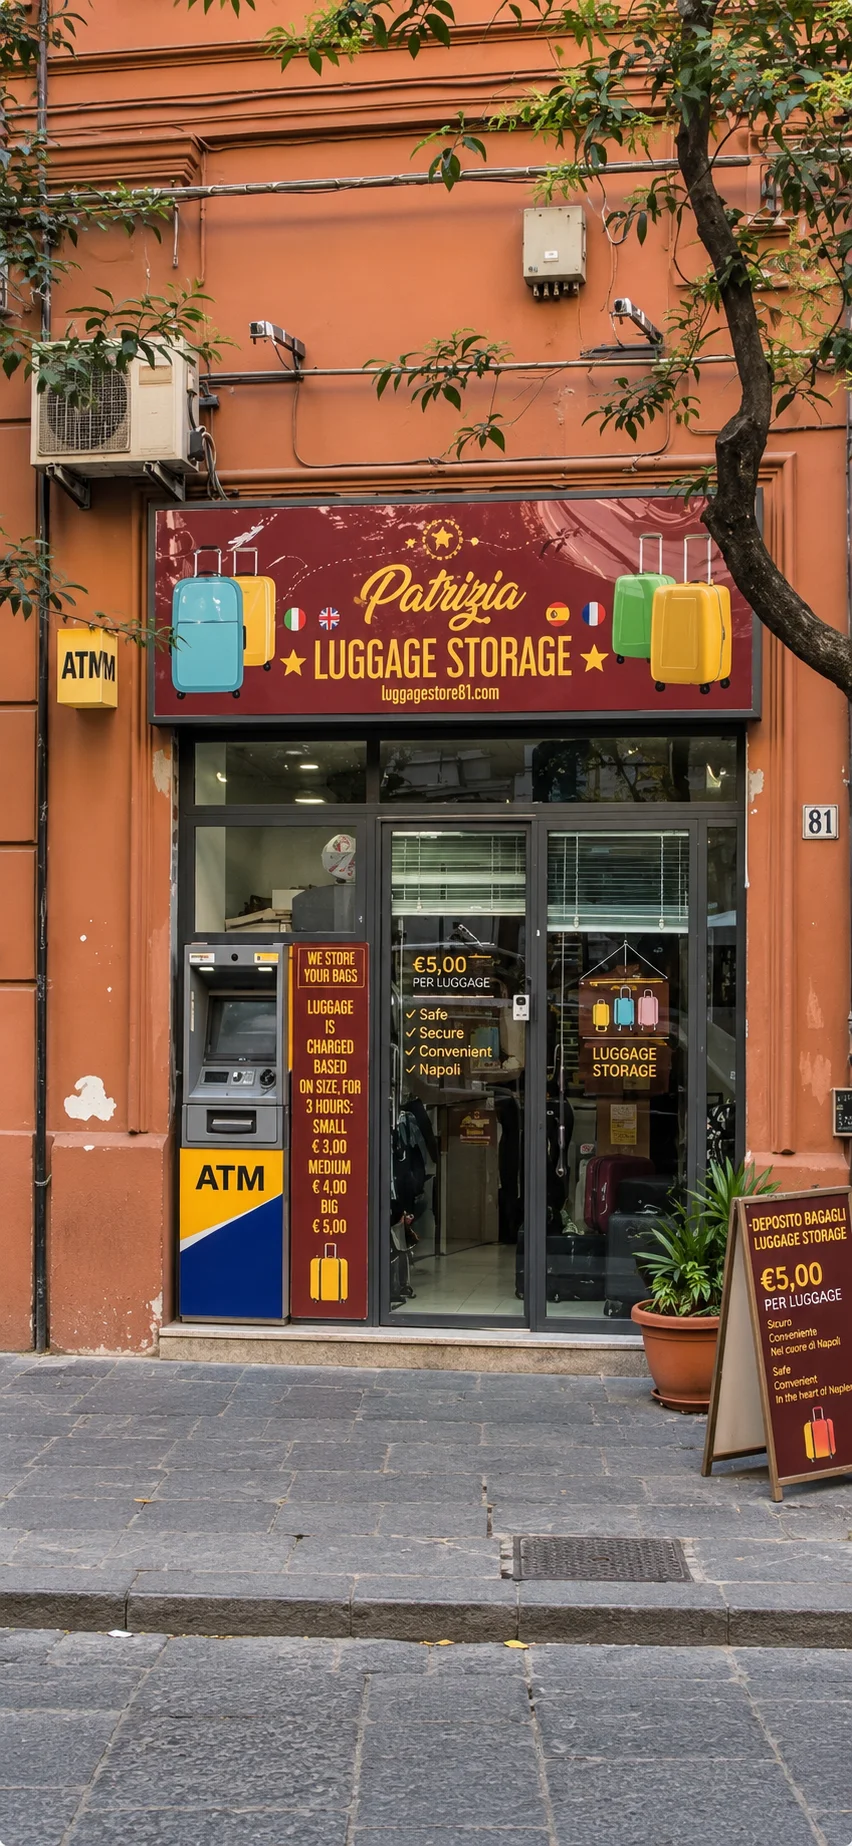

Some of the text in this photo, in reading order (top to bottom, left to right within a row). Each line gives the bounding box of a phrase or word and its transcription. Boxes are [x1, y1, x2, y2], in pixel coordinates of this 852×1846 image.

[359, 563, 527, 632] Patrizia
[314, 635, 573, 680] LUGGAGE STORAGE
[381, 684, 500, 704] luggagestore81.com
[808, 809, 832, 834] 81
[307, 951, 355, 966] WE STORE
[412, 956, 467, 976] €5,00
[304, 968, 358, 983] YOUR BAGS
[413, 977, 491, 988] PER LUGGAGE
[307, 999, 354, 1015] LUGGAGE
[419, 1007, 448, 1020] Safe
[325, 1019, 336, 1034] IS
[419, 1026, 464, 1039] Secure
[306, 1039, 354, 1054] CHARGED
[419, 1044, 492, 1058] Convenient
[592, 1047, 657, 1061] LUGGAGE
[313, 1059, 347, 1074] BASED
[419, 1063, 461, 1078] Napoli
[592, 1063, 657, 1078] STORAGE
[299, 1079, 361, 1095] ON SIZE, FOR
[305, 1098, 354, 1114] 3 HOURS:
[312, 1119, 347, 1134] SMALL
[311, 1139, 347, 1156] € 3,00
[308, 1159, 351, 1175] MEDIUM
[195, 1164, 265, 1191] ATM
[311, 1179, 347, 1197] € 4,00
[321, 1199, 338, 1214] BIG
[804, 1208, 846, 1225] BAGAGLI
[312, 1218, 347, 1236] € 5,00
[754, 1226, 847, 1250] LUGGAGE STORAGE
[760, 1261, 823, 1293] €5,00
[764, 1288, 842, 1312] PER LUGGAGE
[770, 1345, 784, 1357] Nel
[785, 1343, 807, 1354] cuore
[817, 1336, 841, 1349] Napoli
[772, 1365, 791, 1376] Safe
[774, 1375, 818, 1390] Convenient
[784, 1392, 798, 1402] the
[799, 1388, 819, 1399] heart
